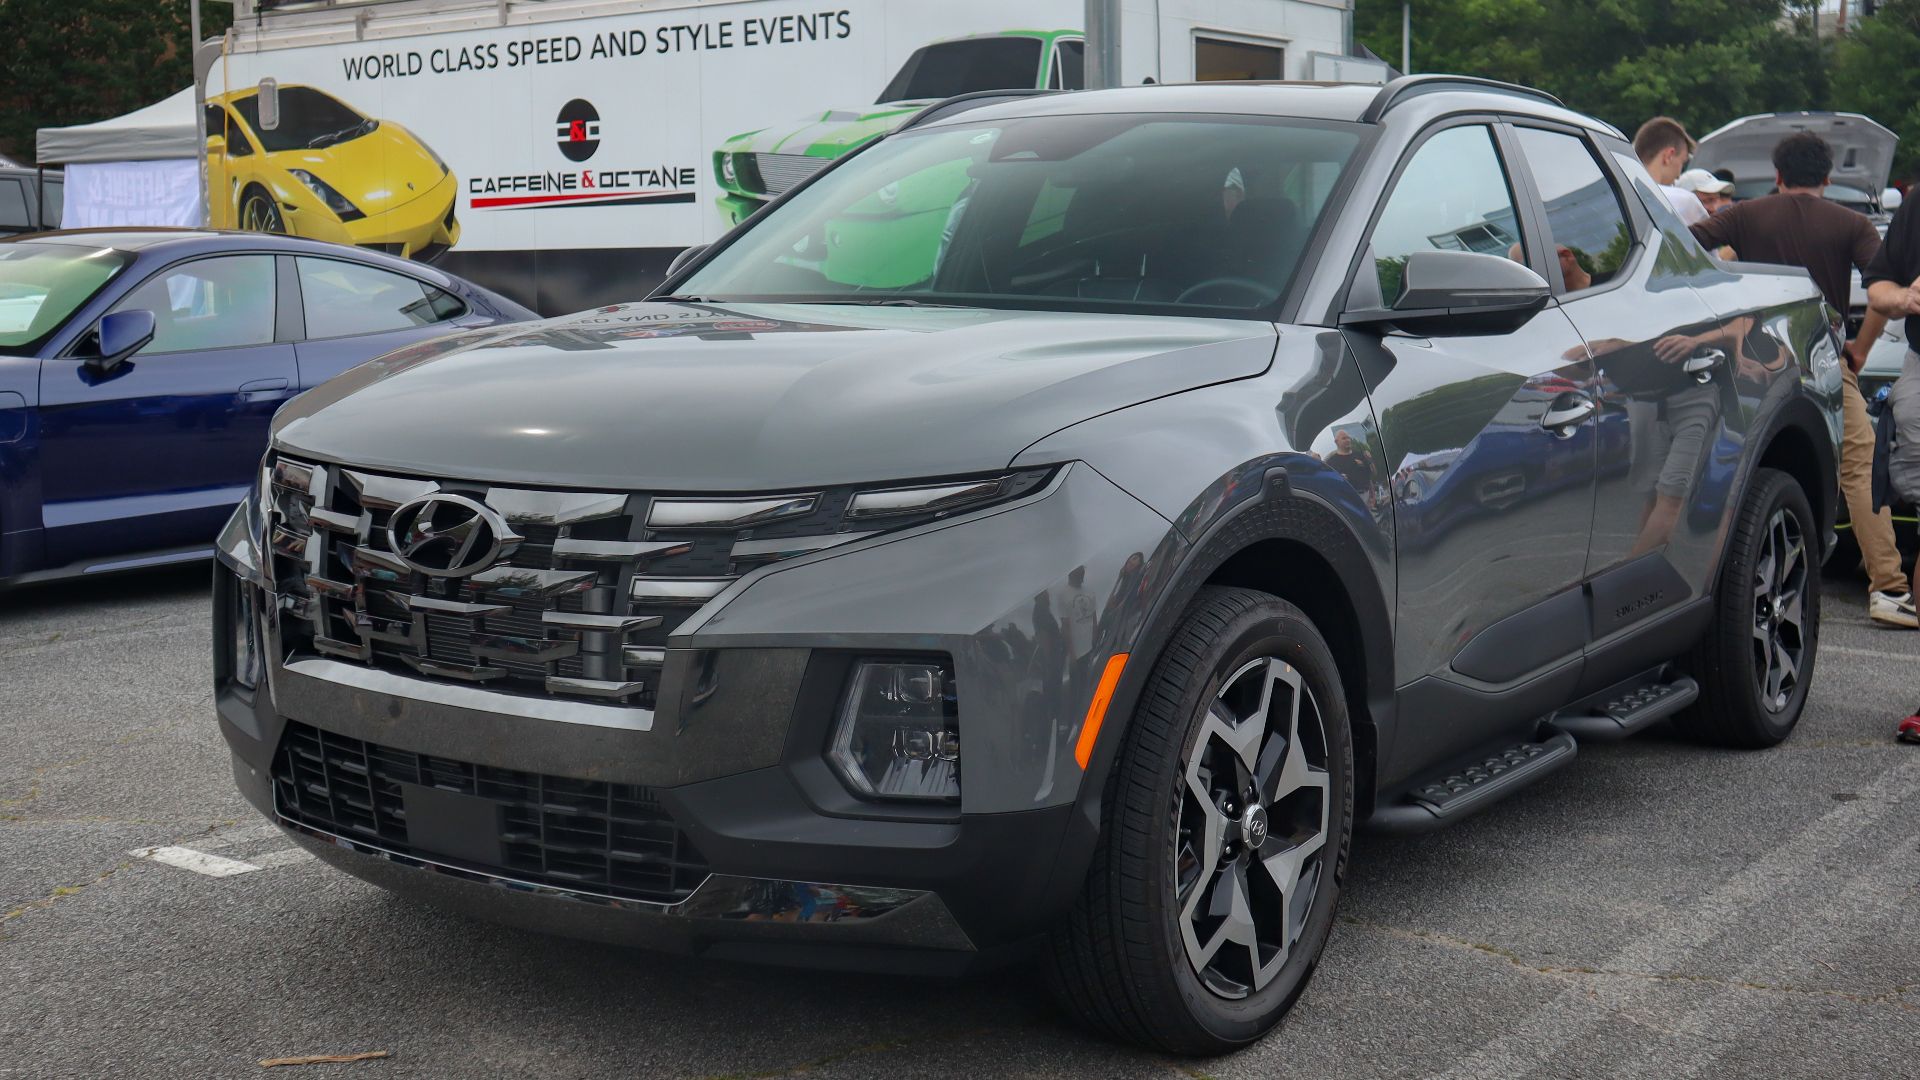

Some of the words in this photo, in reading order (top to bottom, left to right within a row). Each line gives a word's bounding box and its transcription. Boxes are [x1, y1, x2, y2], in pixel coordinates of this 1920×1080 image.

[343, 52, 423, 81] WORLD
[430, 43, 499, 74] CLASS
[507, 36, 582, 67] SPEED
[590, 30, 647, 60] AND
[656, 21, 733, 54] STYLE
[744, 9, 851, 47] EVENTS
[469, 170, 577, 194] CAFFEINE
[581, 170, 596, 189] &
[599, 165, 696, 190] OCTANE
